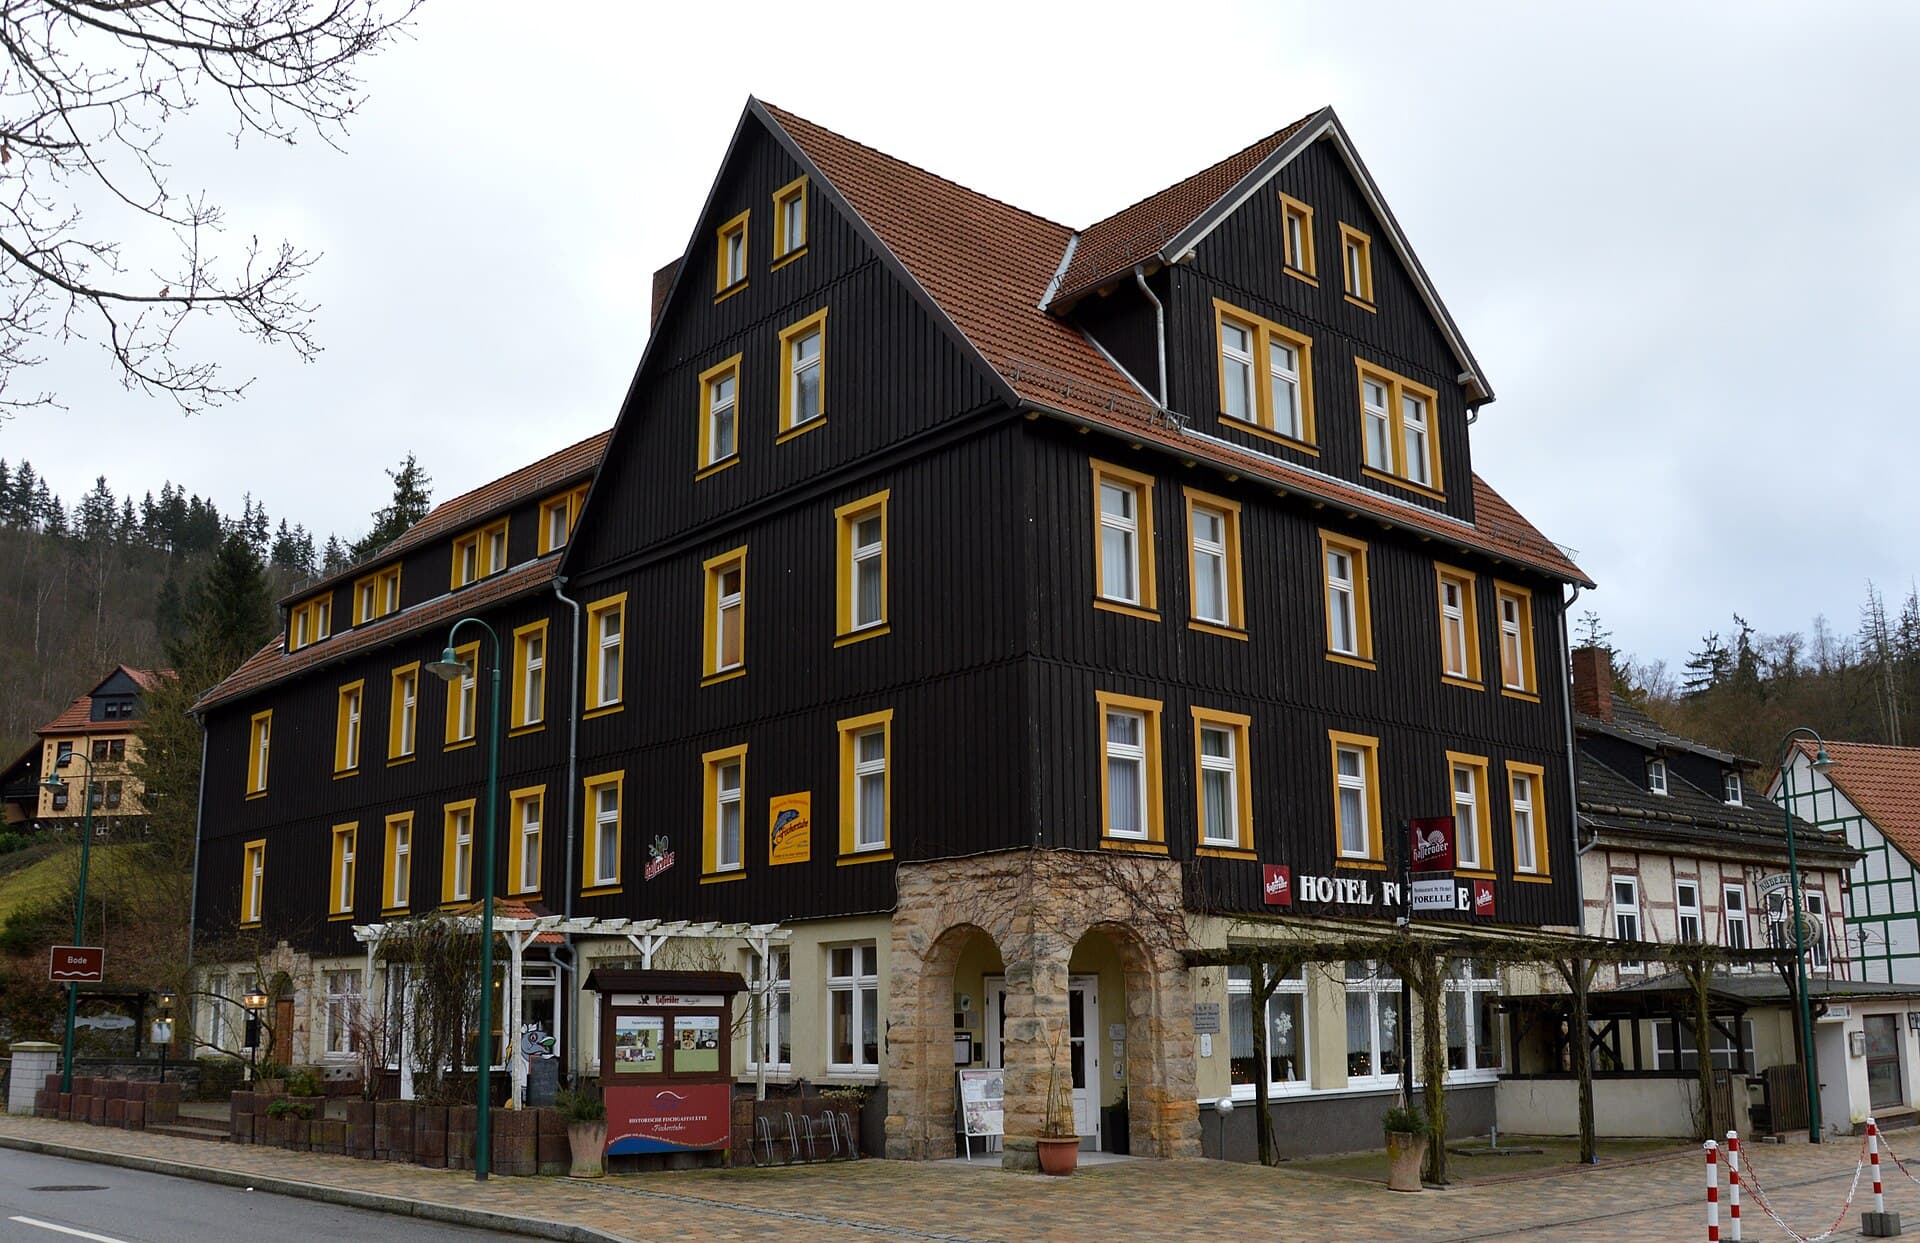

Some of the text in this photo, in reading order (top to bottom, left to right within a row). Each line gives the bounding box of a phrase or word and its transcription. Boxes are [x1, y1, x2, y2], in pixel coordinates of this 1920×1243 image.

[1299, 875, 1374, 906] HOTEL
[1414, 894, 1453, 904] FORELLE
[67, 955, 88, 965] Bode
